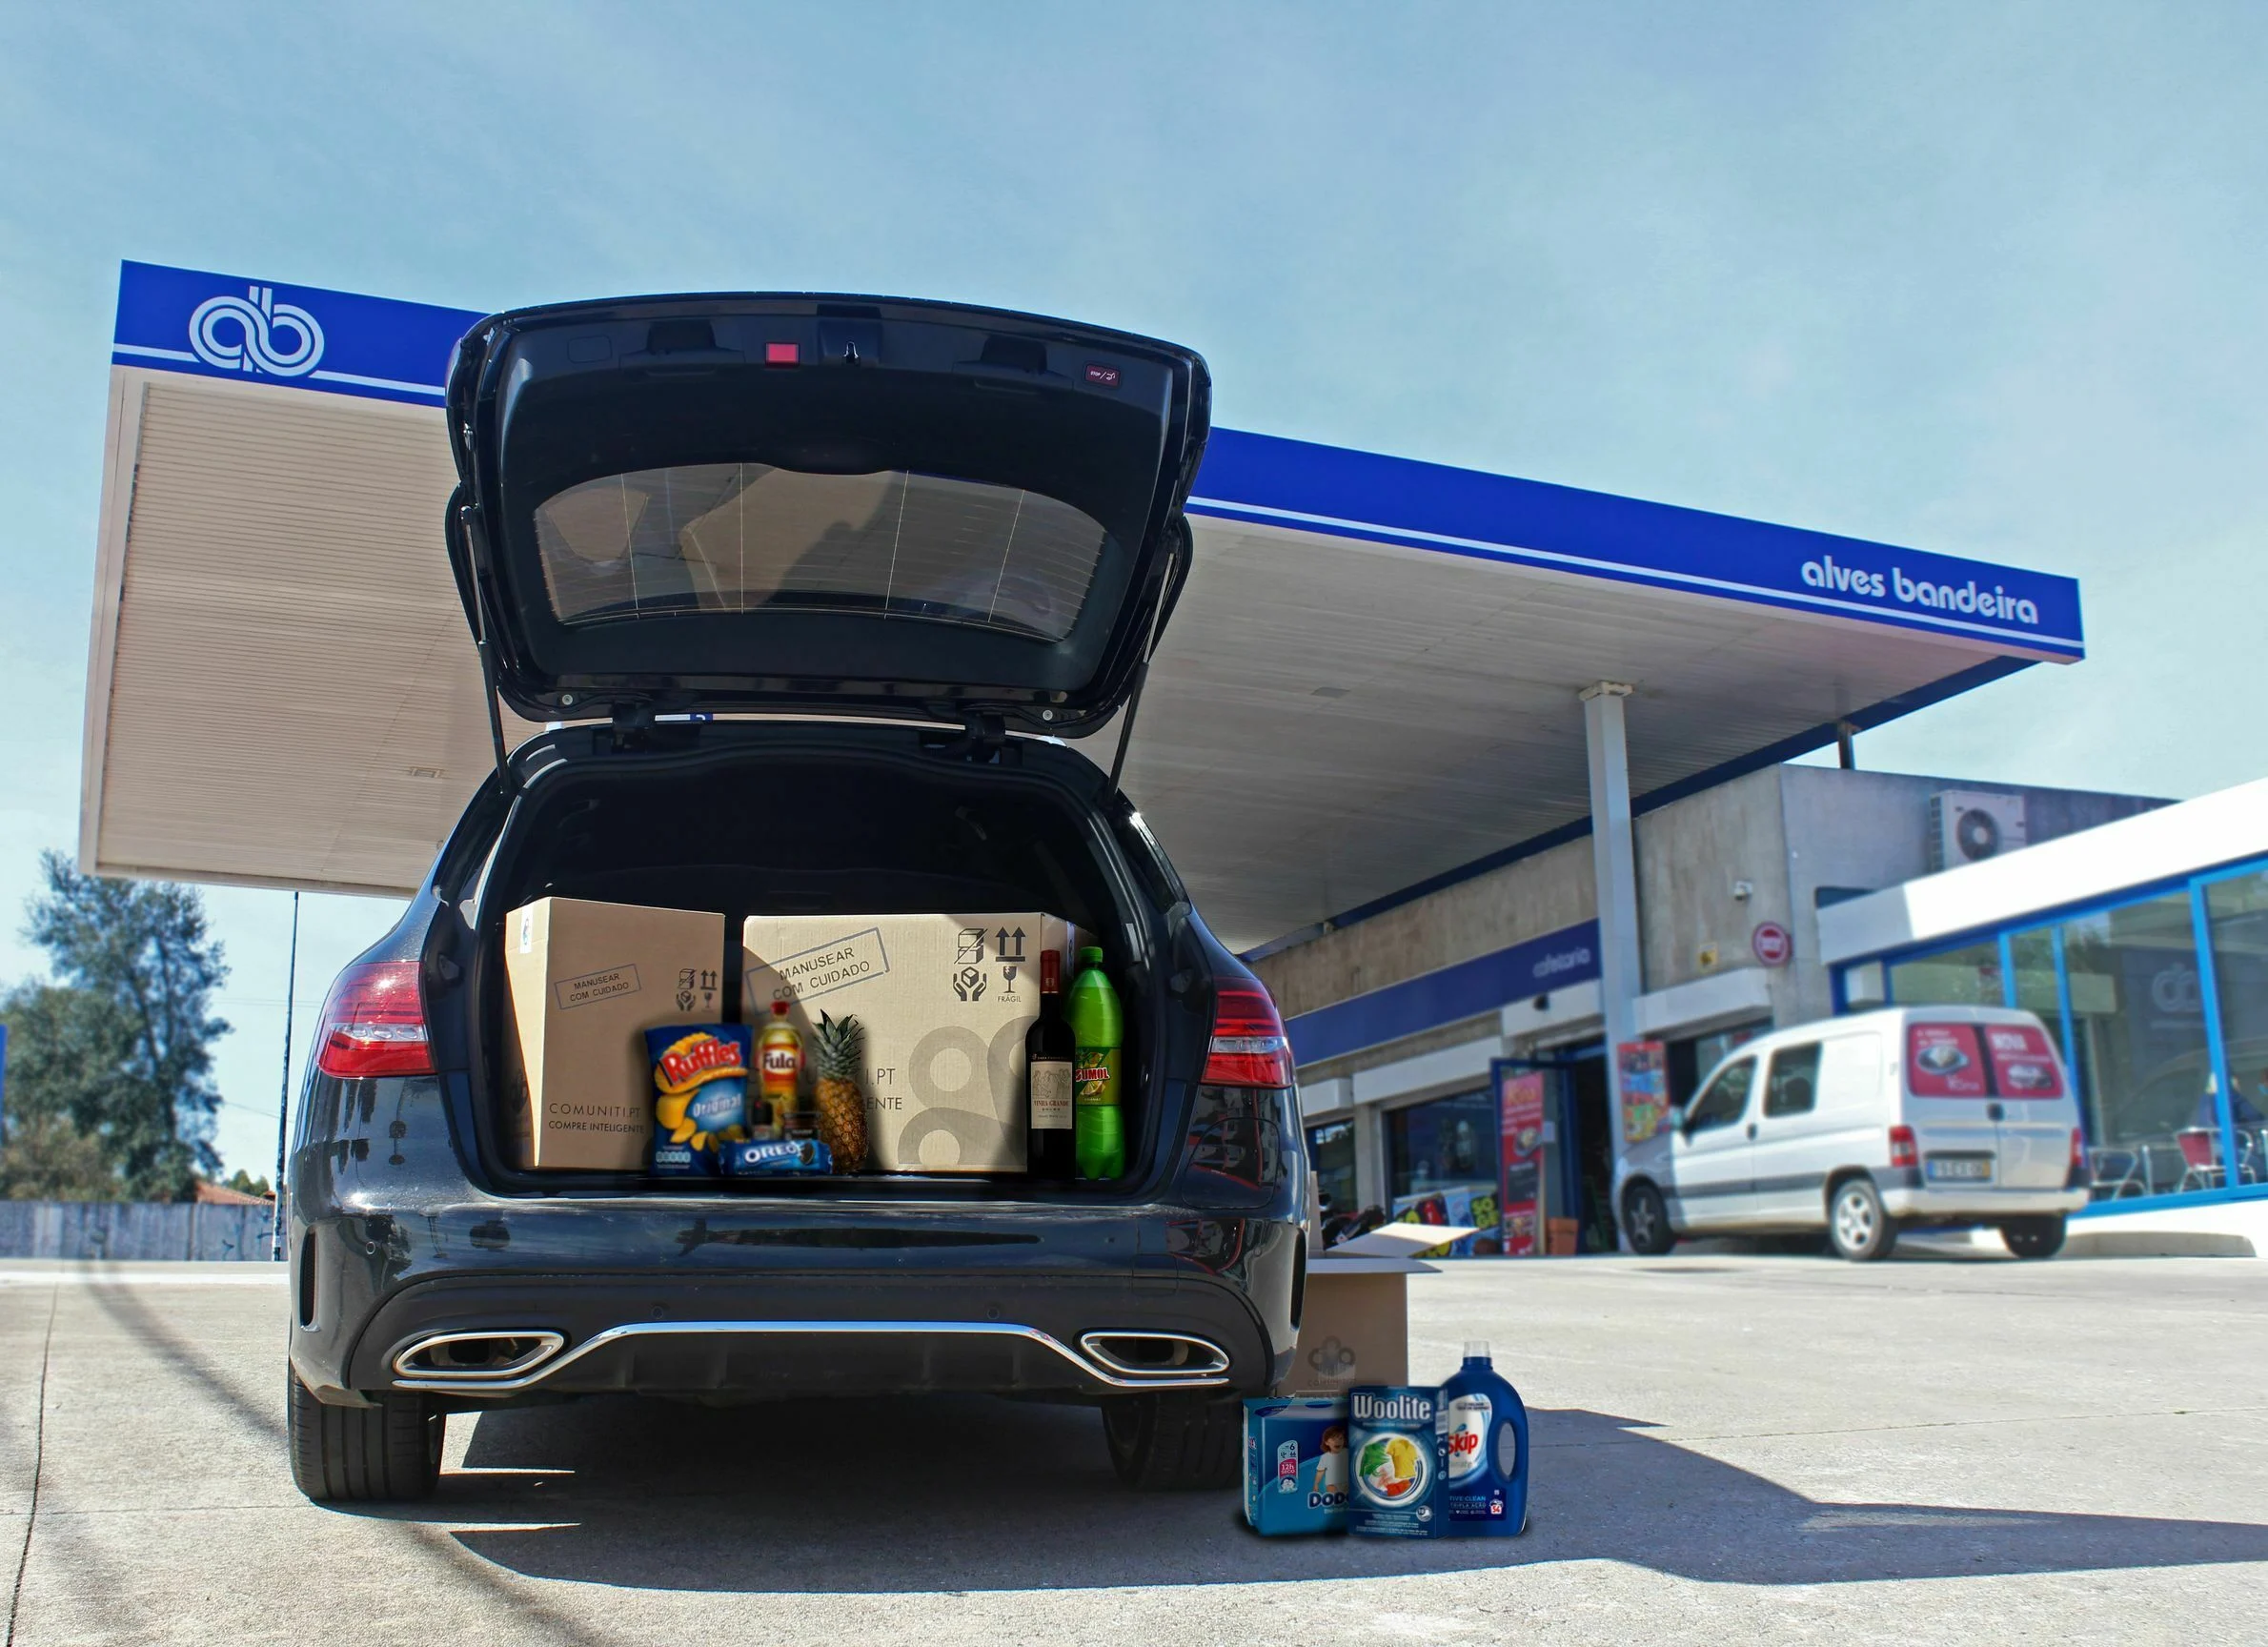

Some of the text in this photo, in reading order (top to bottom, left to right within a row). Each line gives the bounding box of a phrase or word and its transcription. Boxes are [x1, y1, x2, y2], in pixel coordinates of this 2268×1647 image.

[1801, 555, 2039, 624] alves bandeira
[779, 946, 855, 981] MANUSEAR
[574, 972, 619, 990] MANUSEAR
[772, 960, 871, 1001] COM CUIDADO
[570, 982, 629, 1002] COM CUIDADO
[997, 994, 1022, 1003] FRÁGIL
[660, 1037, 742, 1086] Ruffles
[763, 1052, 797, 1068] Fula
[1076, 1068, 1110, 1082] SUMOL
[549, 1103, 641, 1118] COMUNITI.PT
[693, 1093, 742, 1117] Original
[548, 1120, 645, 1134] COMPRE INTELIGENTE
[744, 1144, 797, 1163] OREO
[1353, 1394, 1431, 1420] Woolite
[1307, 1491, 1349, 1509] DOD
